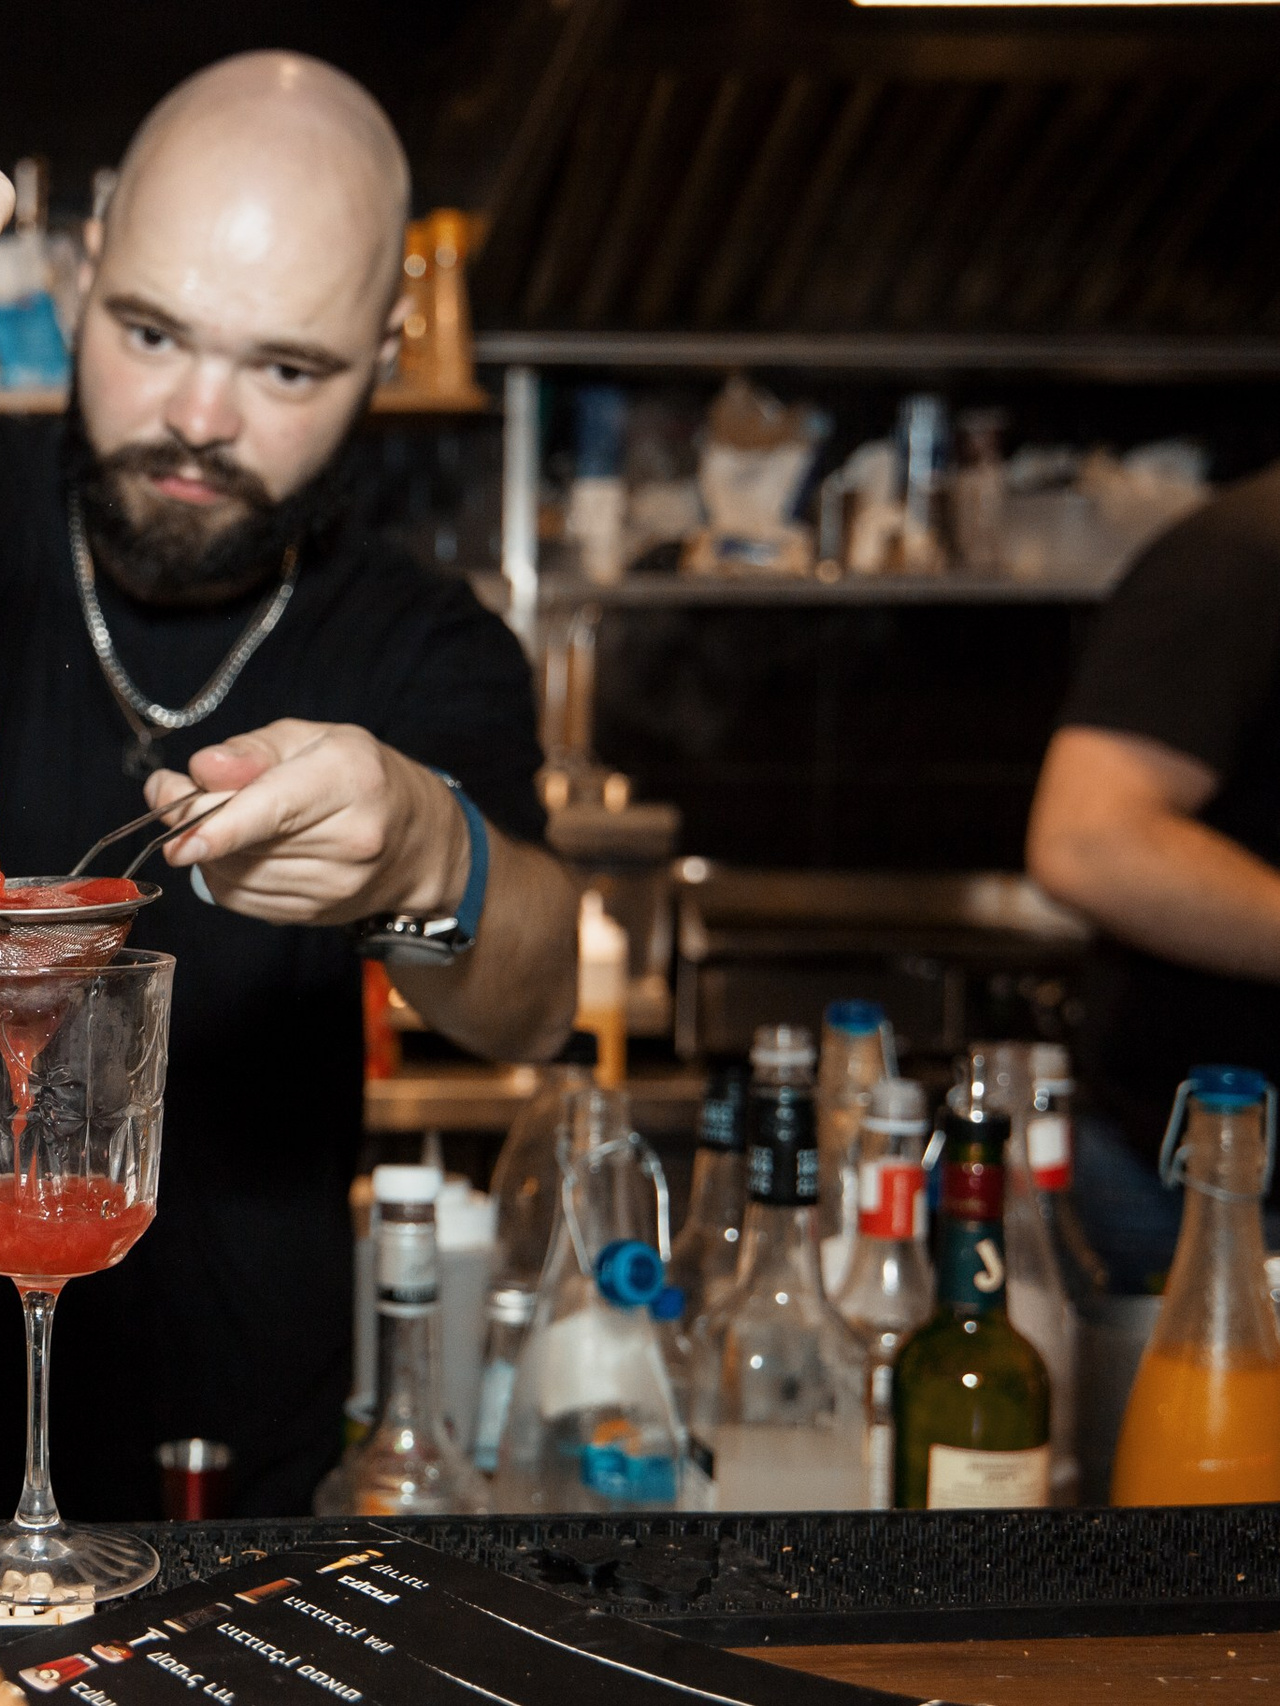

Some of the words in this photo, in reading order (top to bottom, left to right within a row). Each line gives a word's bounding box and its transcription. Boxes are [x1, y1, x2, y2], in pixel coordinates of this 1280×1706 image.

[337, 1574, 401, 1605] בקבוק
[370, 1563, 430, 1590] קורונה
[282, 1595, 367, 1639] הובגובלין
[363, 1634, 396, 1655] IPA
[146, 1651, 205, 1689] קסטיל
[216, 1621, 302, 1668] הובגובלין
[296, 1664, 363, 1703] סטאוט
